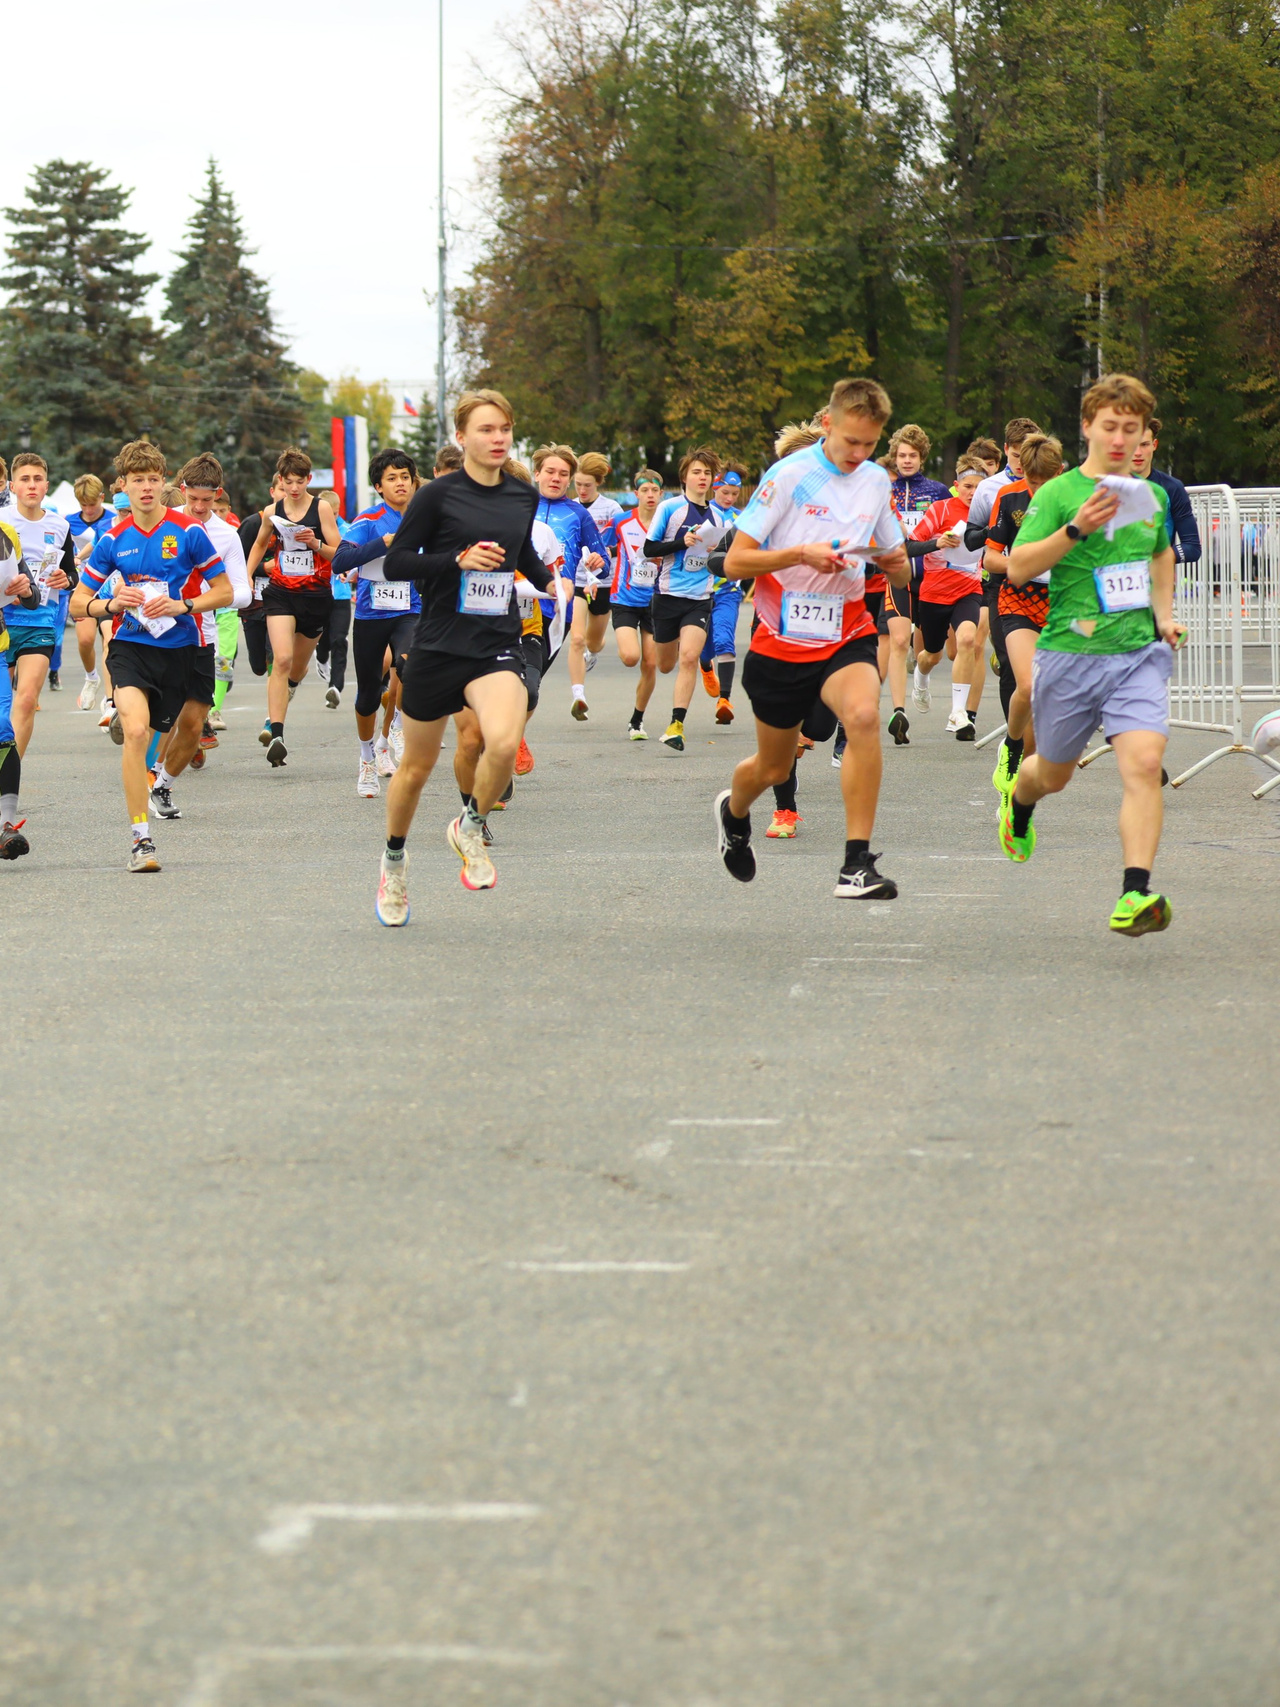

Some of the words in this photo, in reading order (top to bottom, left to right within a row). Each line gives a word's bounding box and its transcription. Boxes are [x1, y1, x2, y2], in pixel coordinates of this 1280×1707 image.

[284, 555, 309, 566] 347.1
[634, 569, 654, 579] 359.1
[467, 582, 506, 598] 308.1
[1105, 575, 1145, 594] 312.1
[375, 588, 404, 600] 354.1
[790, 604, 834, 622] 327.1
